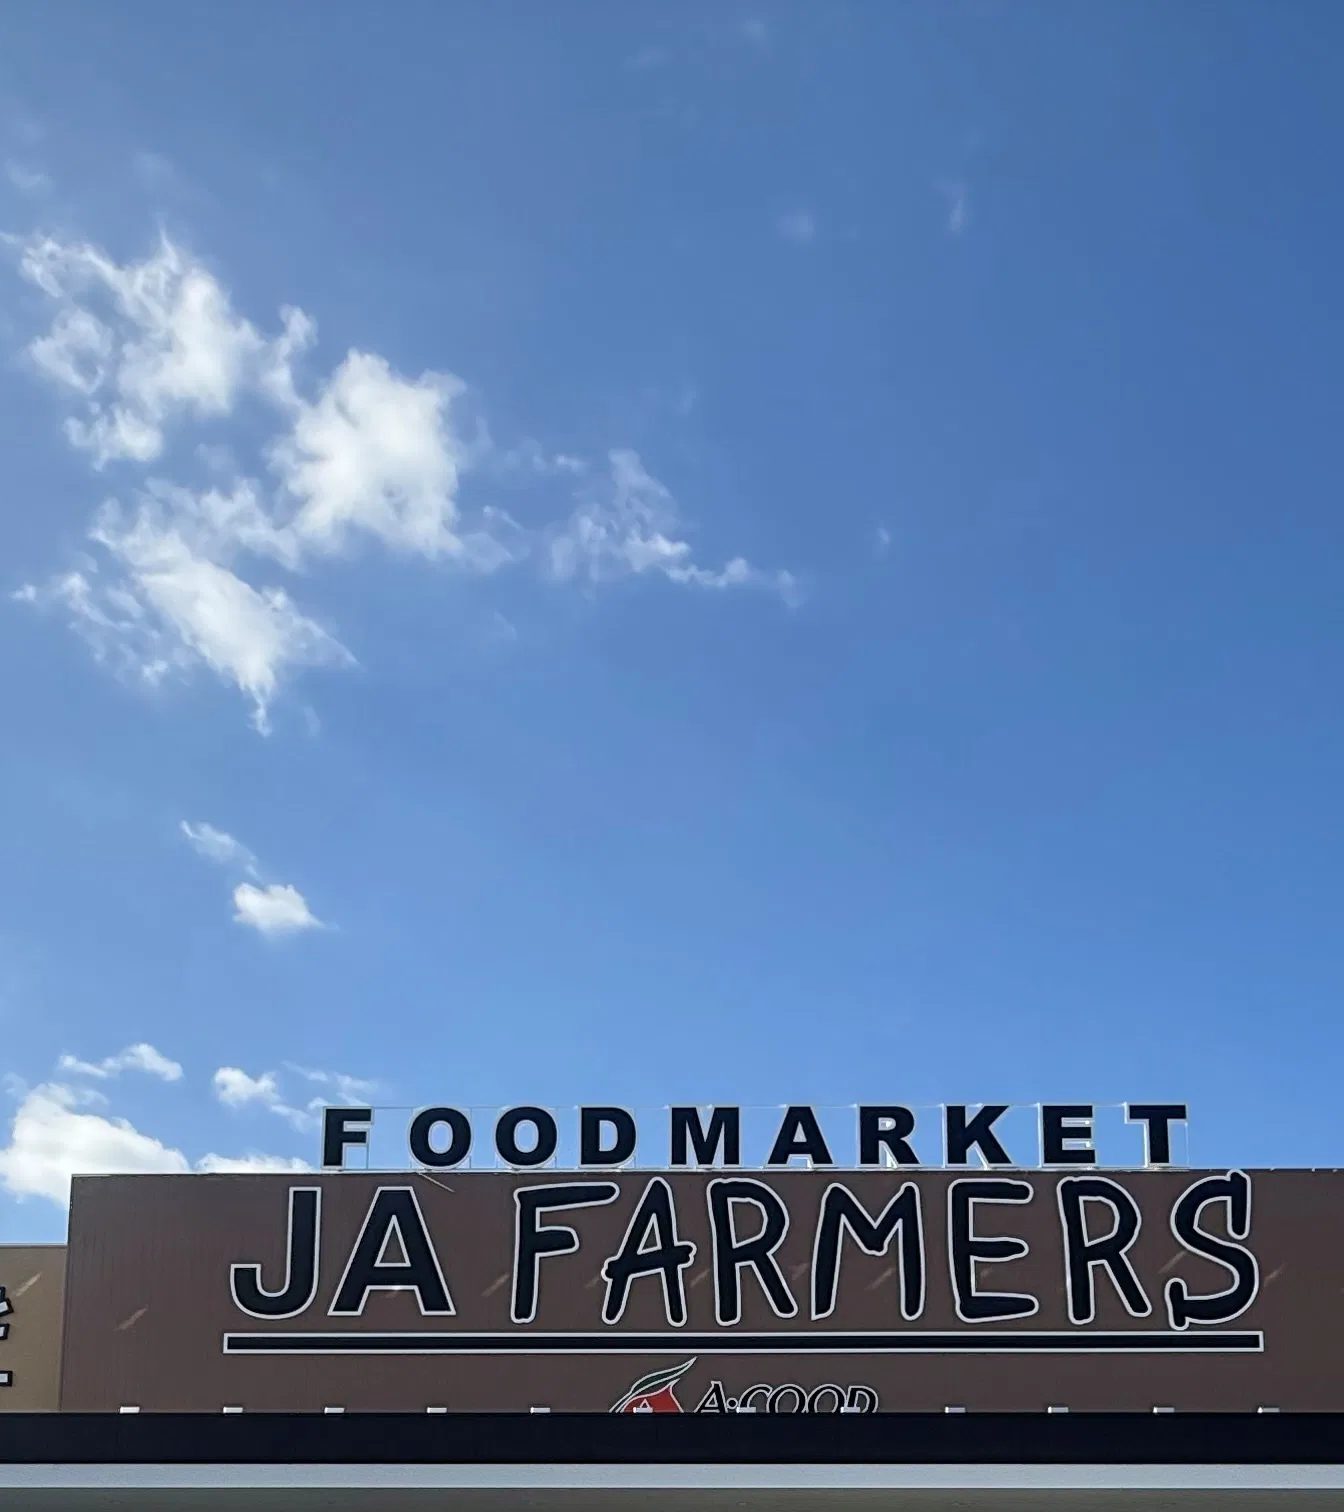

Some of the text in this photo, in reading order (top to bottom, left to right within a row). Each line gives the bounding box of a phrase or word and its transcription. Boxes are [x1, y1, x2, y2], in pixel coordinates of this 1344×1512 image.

[322, 1105, 1188, 1169] FOODMARKET
[230, 1170, 1260, 1331] JA FARMERS
